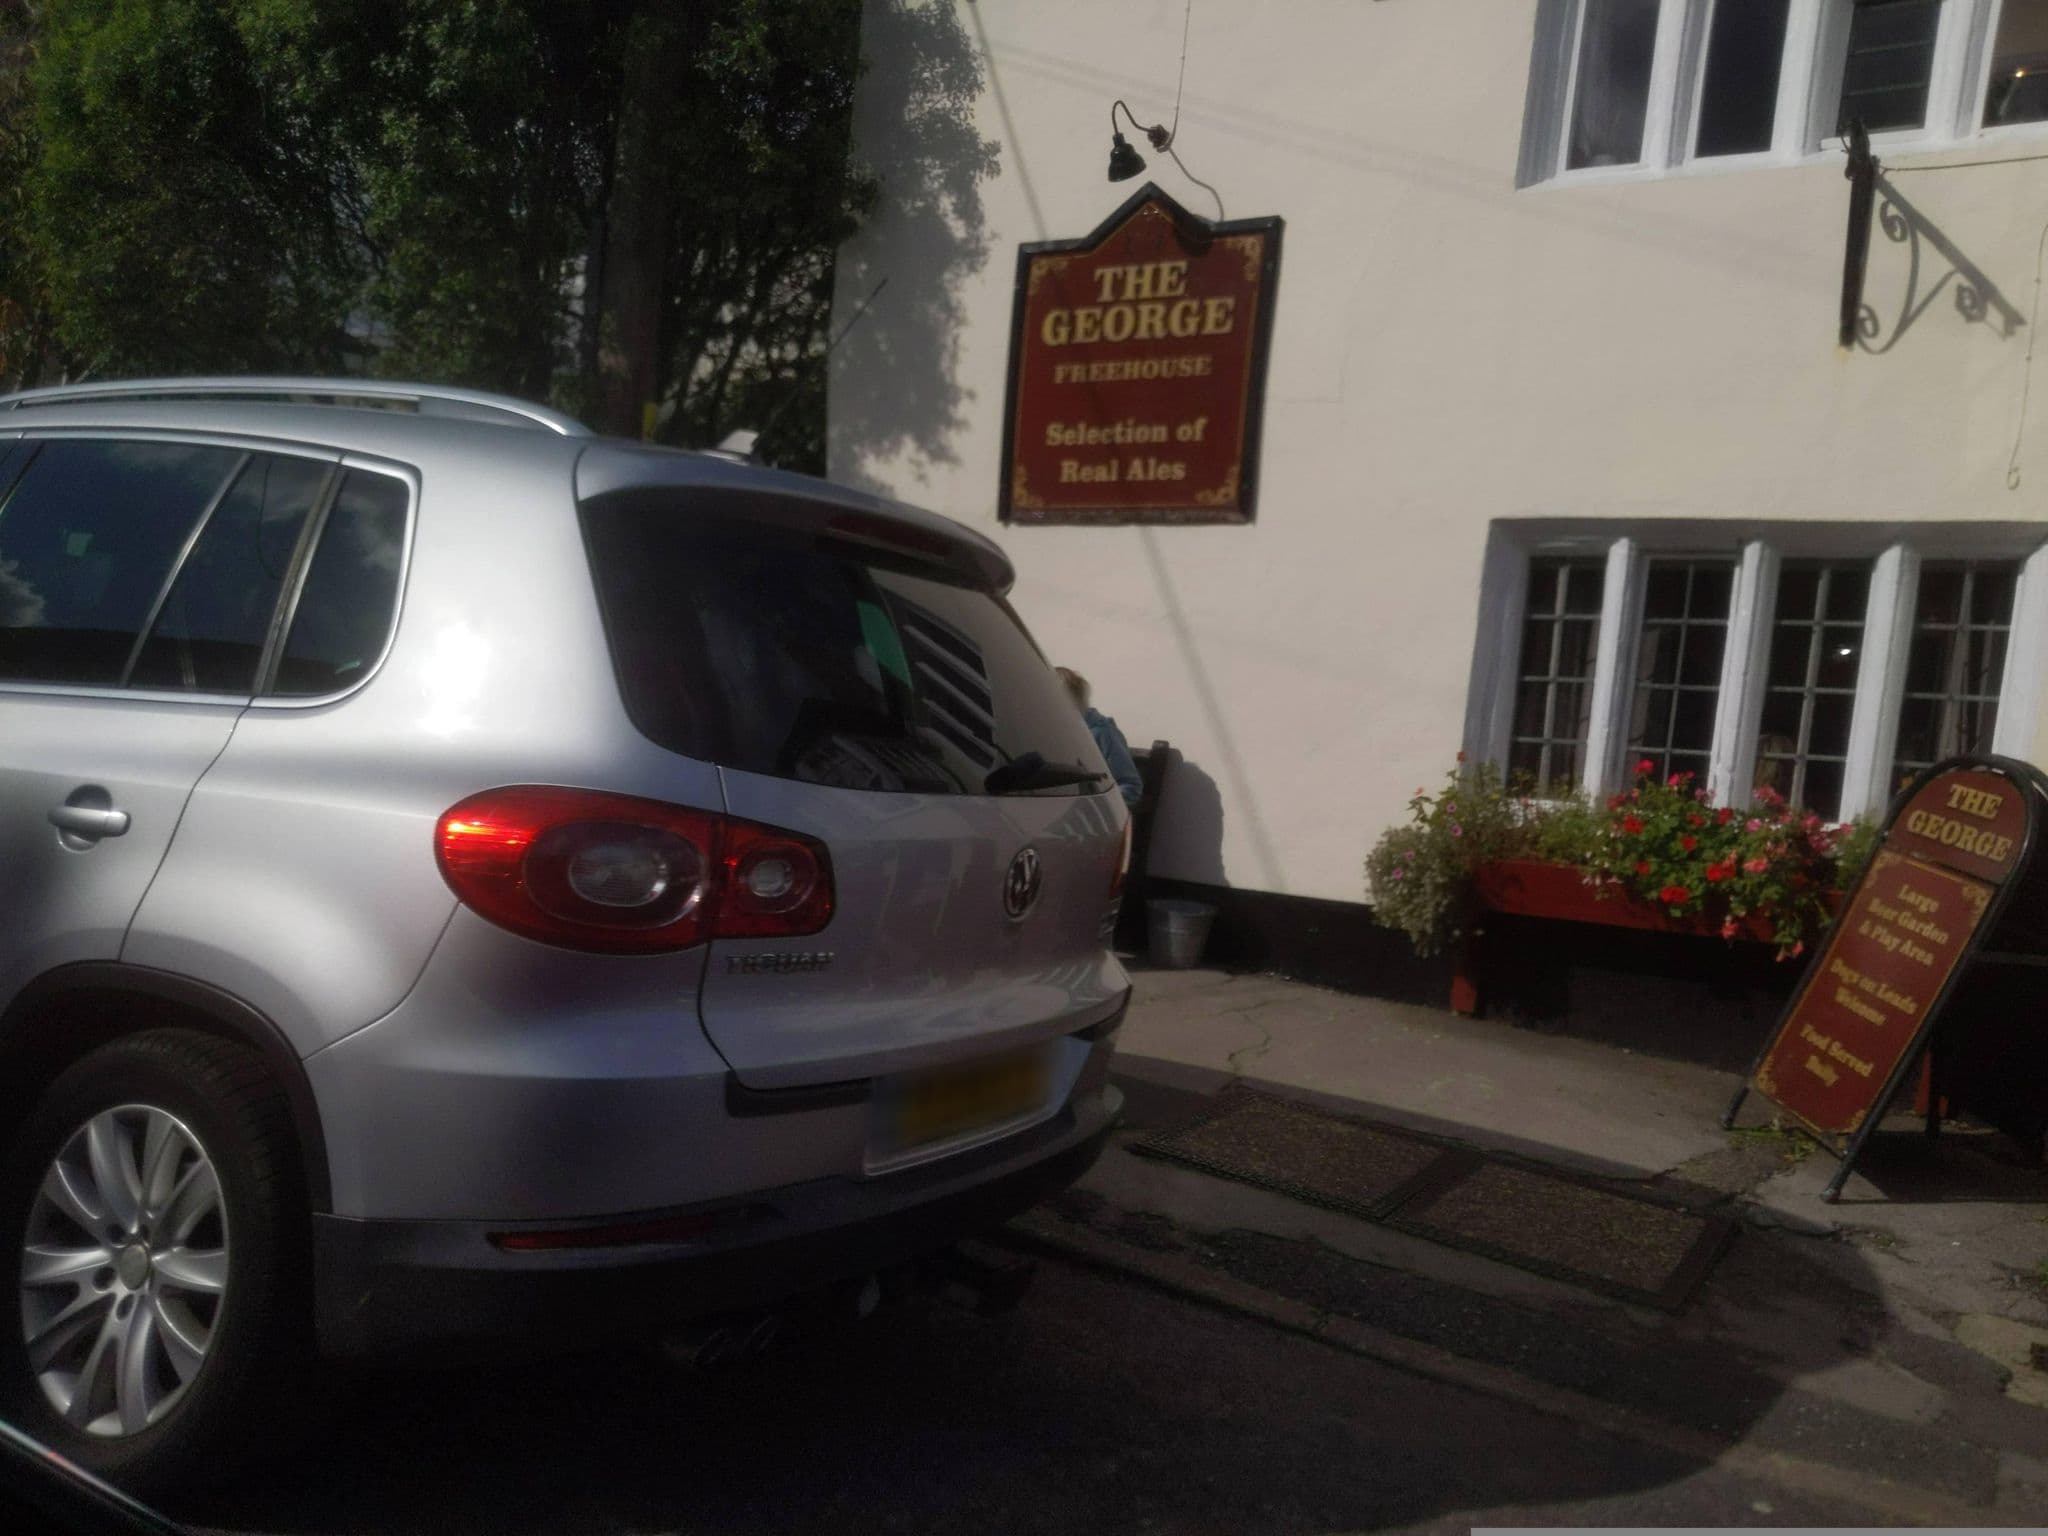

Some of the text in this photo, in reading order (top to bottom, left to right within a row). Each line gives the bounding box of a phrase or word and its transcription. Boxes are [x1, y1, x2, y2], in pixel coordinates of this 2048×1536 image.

[1095, 262, 1186, 302] THE
[1041, 298, 1235, 346] GEORGE
[1054, 356, 1213, 384] FREEHOUSE
[1047, 417, 1208, 446] Selection of
[1060, 457, 1186, 483] Real Ales
[1948, 784, 2002, 818] THE
[1908, 810, 2011, 860] GEORGE
[1897, 884, 1939, 912] Large
[1898, 911, 1949, 944] Garden
[1870, 925, 1901, 952] Play
[1899, 940, 1935, 966] Area
[1827, 1041, 1874, 1077] Served
